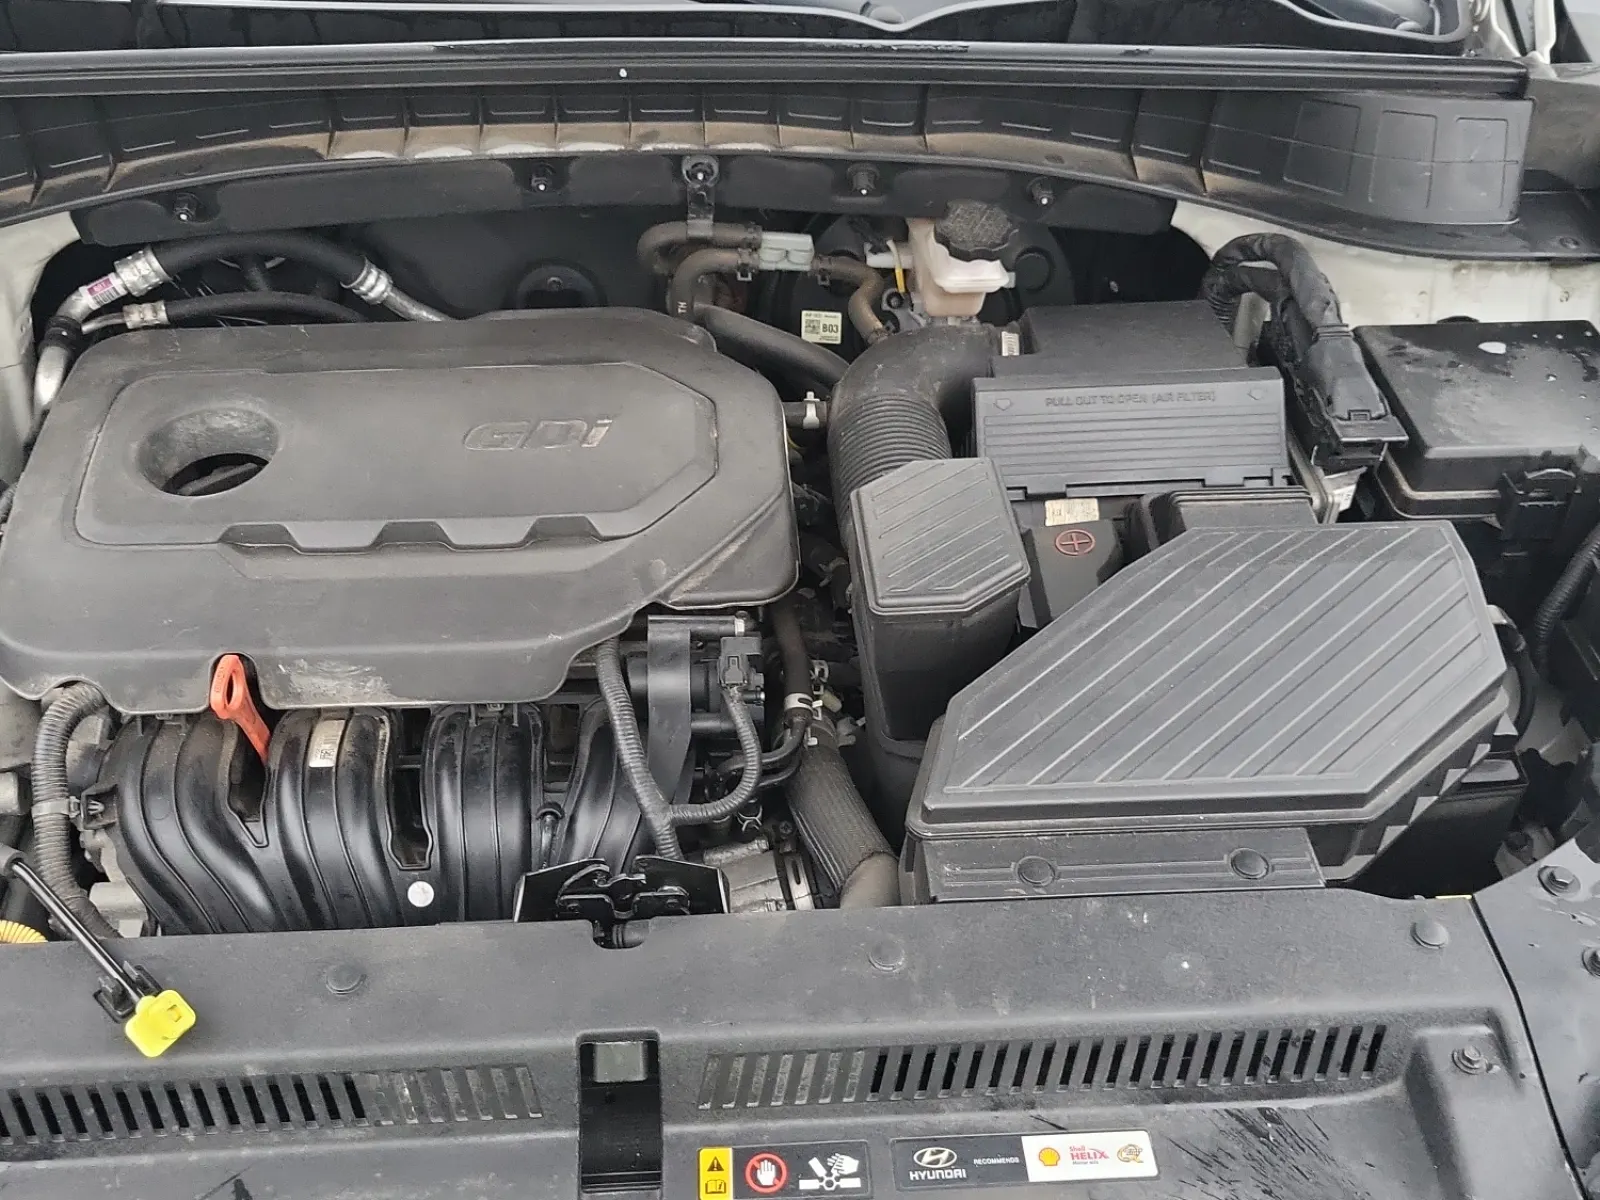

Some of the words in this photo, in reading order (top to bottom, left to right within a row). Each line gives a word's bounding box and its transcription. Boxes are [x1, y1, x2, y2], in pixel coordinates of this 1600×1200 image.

[1045, 396, 1073, 407] PULL
[1075, 395, 1098, 406] OUT
[1100, 395, 1114, 405] TO
[1118, 393, 1148, 404] OPEN
[1152, 392, 1175, 404] (AIR
[1177, 390, 1216, 403] FILTER)
[462, 417, 613, 451] GDi
[973, 1156, 1020, 1165] RECOMMENDS
[1070, 1151, 1109, 1161] HELIX
[909, 1168, 967, 1181] HYUNDAI
